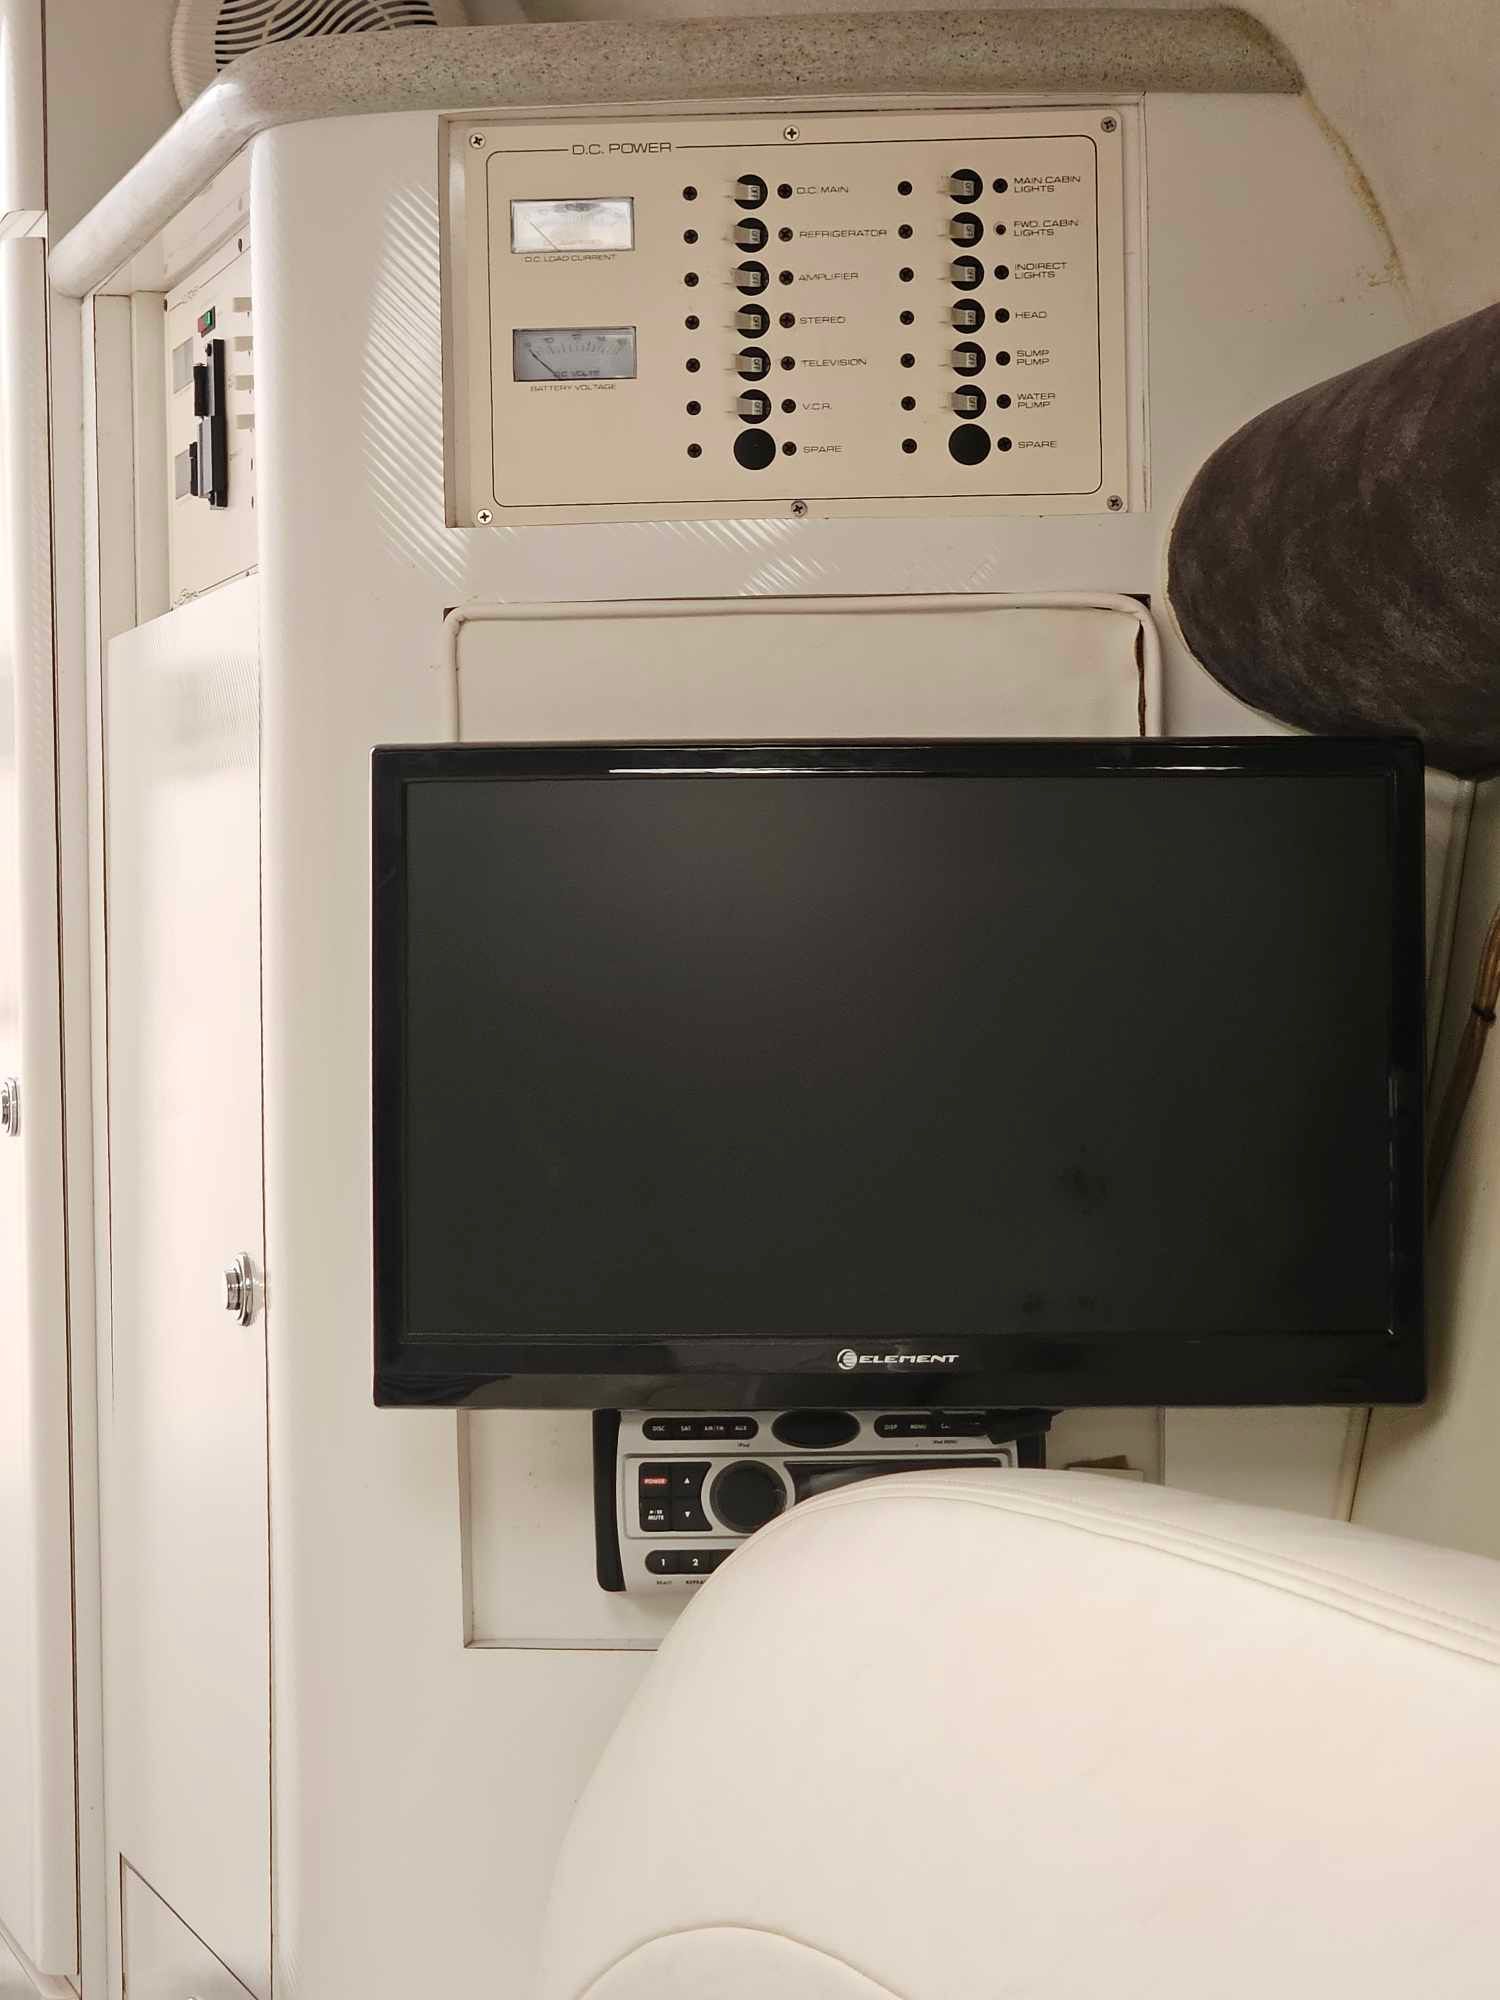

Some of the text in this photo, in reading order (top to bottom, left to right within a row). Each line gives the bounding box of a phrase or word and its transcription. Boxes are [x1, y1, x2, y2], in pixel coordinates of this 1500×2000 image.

[571, 142, 672, 156] D.C. POWER
[1014, 175, 1081, 185] MAIN CABIN
[820, 186, 849, 194] MAIN
[1013, 184, 1055, 193] LIGHTS
[1043, 218, 1079, 228] CABIN
[799, 228, 888, 239] REFRIGERATOR
[1013, 228, 1055, 237] LIGHTS
[543, 255, 570, 263] LOAD
[570, 253, 616, 262] CURRENT
[1014, 262, 1067, 271] INDIRECT
[798, 271, 859, 281] AMPLIFIER
[1014, 271, 1056, 280] LIGHTS
[799, 315, 846, 325] STEREO
[1015, 311, 1048, 320] HEAD
[1016, 349, 1050, 358] SUMP
[801, 357, 868, 368] TELEVISION
[1016, 358, 1050, 366] PUMP
[530, 383, 617, 393] BATTERY VOLTAGE
[1017, 392, 1056, 401] WATER
[1017, 401, 1051, 410] PUMP
[1018, 440, 1058, 449] SPARE
[803, 445, 843, 454] SPARE
[859, 1354, 959, 1363] ELEMENT
[692, 1559, 699, 1567] 2
